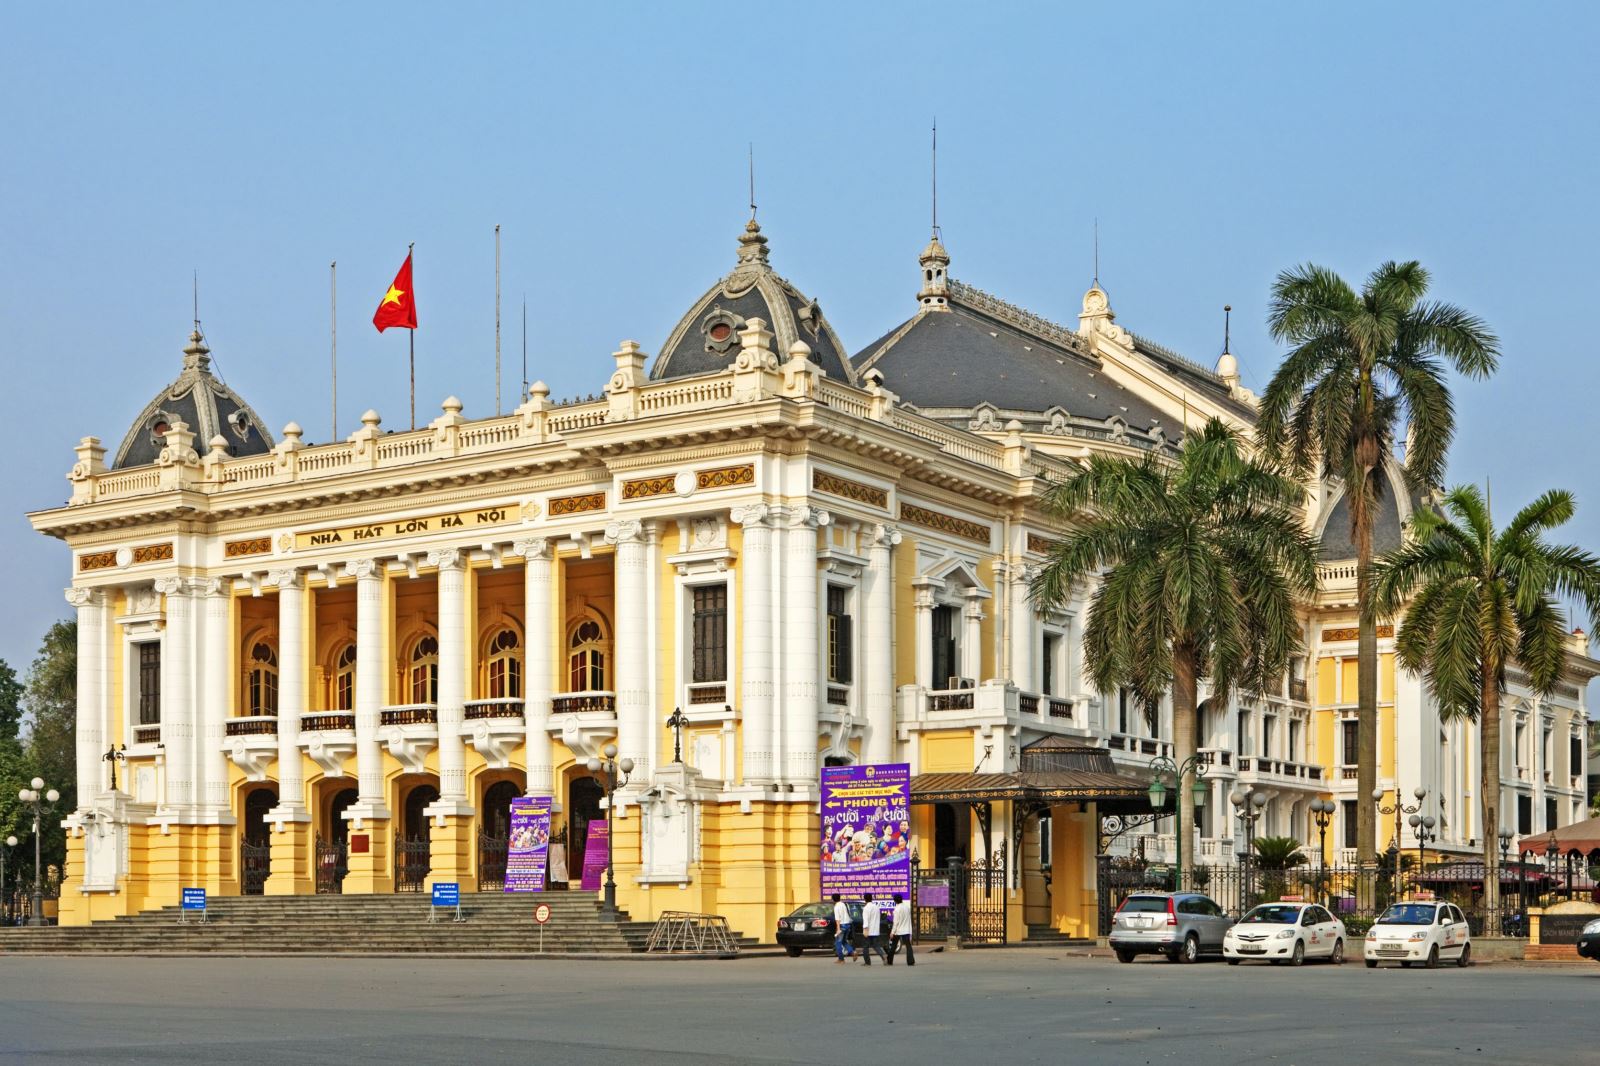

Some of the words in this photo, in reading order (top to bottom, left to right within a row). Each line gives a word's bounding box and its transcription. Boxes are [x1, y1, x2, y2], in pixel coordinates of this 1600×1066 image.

[310, 530, 342, 545] NHÀ
[353, 525, 384, 540] HÁT
[395, 520, 429, 534] LỚN
[441, 515, 464, 528] HÀ
[477, 509, 506, 523] NỘI
[843, 797, 889, 808] PHÒNG
[891, 795, 906, 806] VÉ
